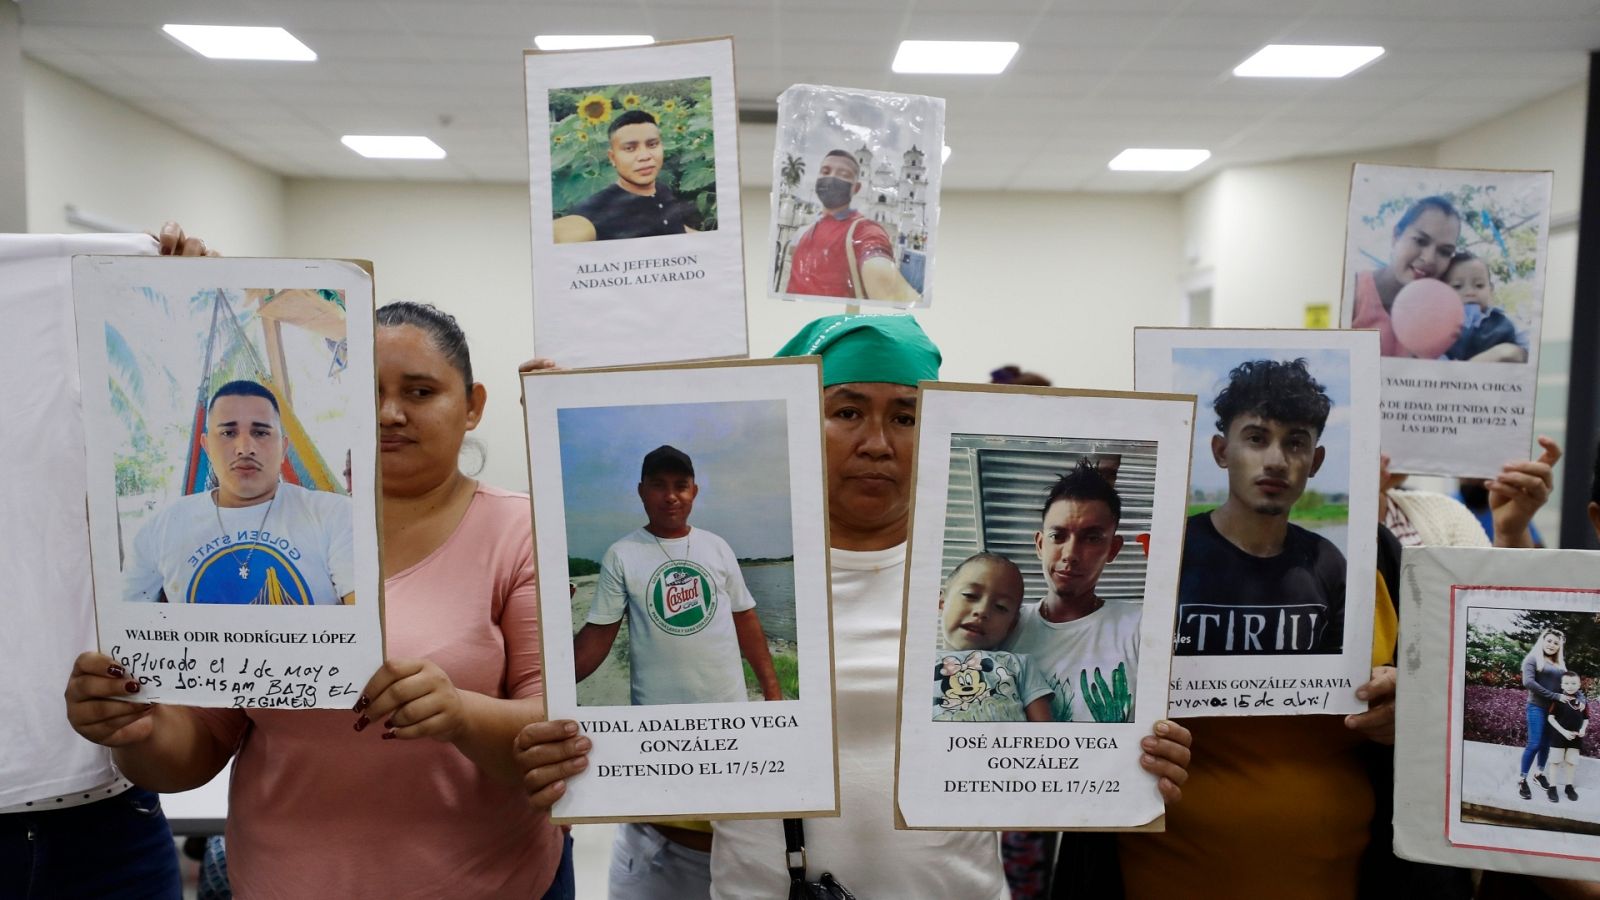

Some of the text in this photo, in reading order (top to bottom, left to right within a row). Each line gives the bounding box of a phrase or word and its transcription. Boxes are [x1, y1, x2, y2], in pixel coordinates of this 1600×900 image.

[576, 255, 699, 274] ALLAN JEFFERSON
[569, 269, 706, 290] ANDASOL ALVARADO
[1440, 381, 1478, 390] PINEDA
[1482, 383, 1523, 392] CHICAS
[1436, 403, 1489, 414] DETENIDA
[1493, 406, 1507, 414] EN
[1511, 407, 1525, 415] SU
[1412, 413, 1453, 424] COMIDA
[1457, 416, 1469, 424] EL
[1511, 418, 1518, 427] A
[1401, 424, 1420, 433] LAS
[1442, 426, 1457, 435] PM
[666, 578, 699, 613] Castrol
[125, 629, 357, 644] WALBER ODIR RODRÍGUEZ LÓPEZ
[209, 657, 225, 674] el
[239, 658, 249, 674] 1
[253, 659, 275, 679] de
[231, 682, 256, 693] AM
[329, 683, 359, 697] EL
[1186, 680, 1227, 690] ALEXIS
[1230, 676, 1297, 689] GONZÁLEZ
[1300, 677, 1352, 689] SARAVIA
[1254, 691, 1274, 707] de
[1283, 691, 1330, 709] abril
[580, 715, 799, 733] VIDAL ADALBETRO VEGA
[640, 736, 739, 753] GONZÁLEZ
[947, 734, 1119, 752] JOSÉ ALFREDO VEGA
[597, 760, 785, 778] DETENIDO EL 17/5/22
[987, 754, 1079, 770] GONZÁLEZ
[943, 780, 1120, 795] DETENIDO EL 17/5/22
